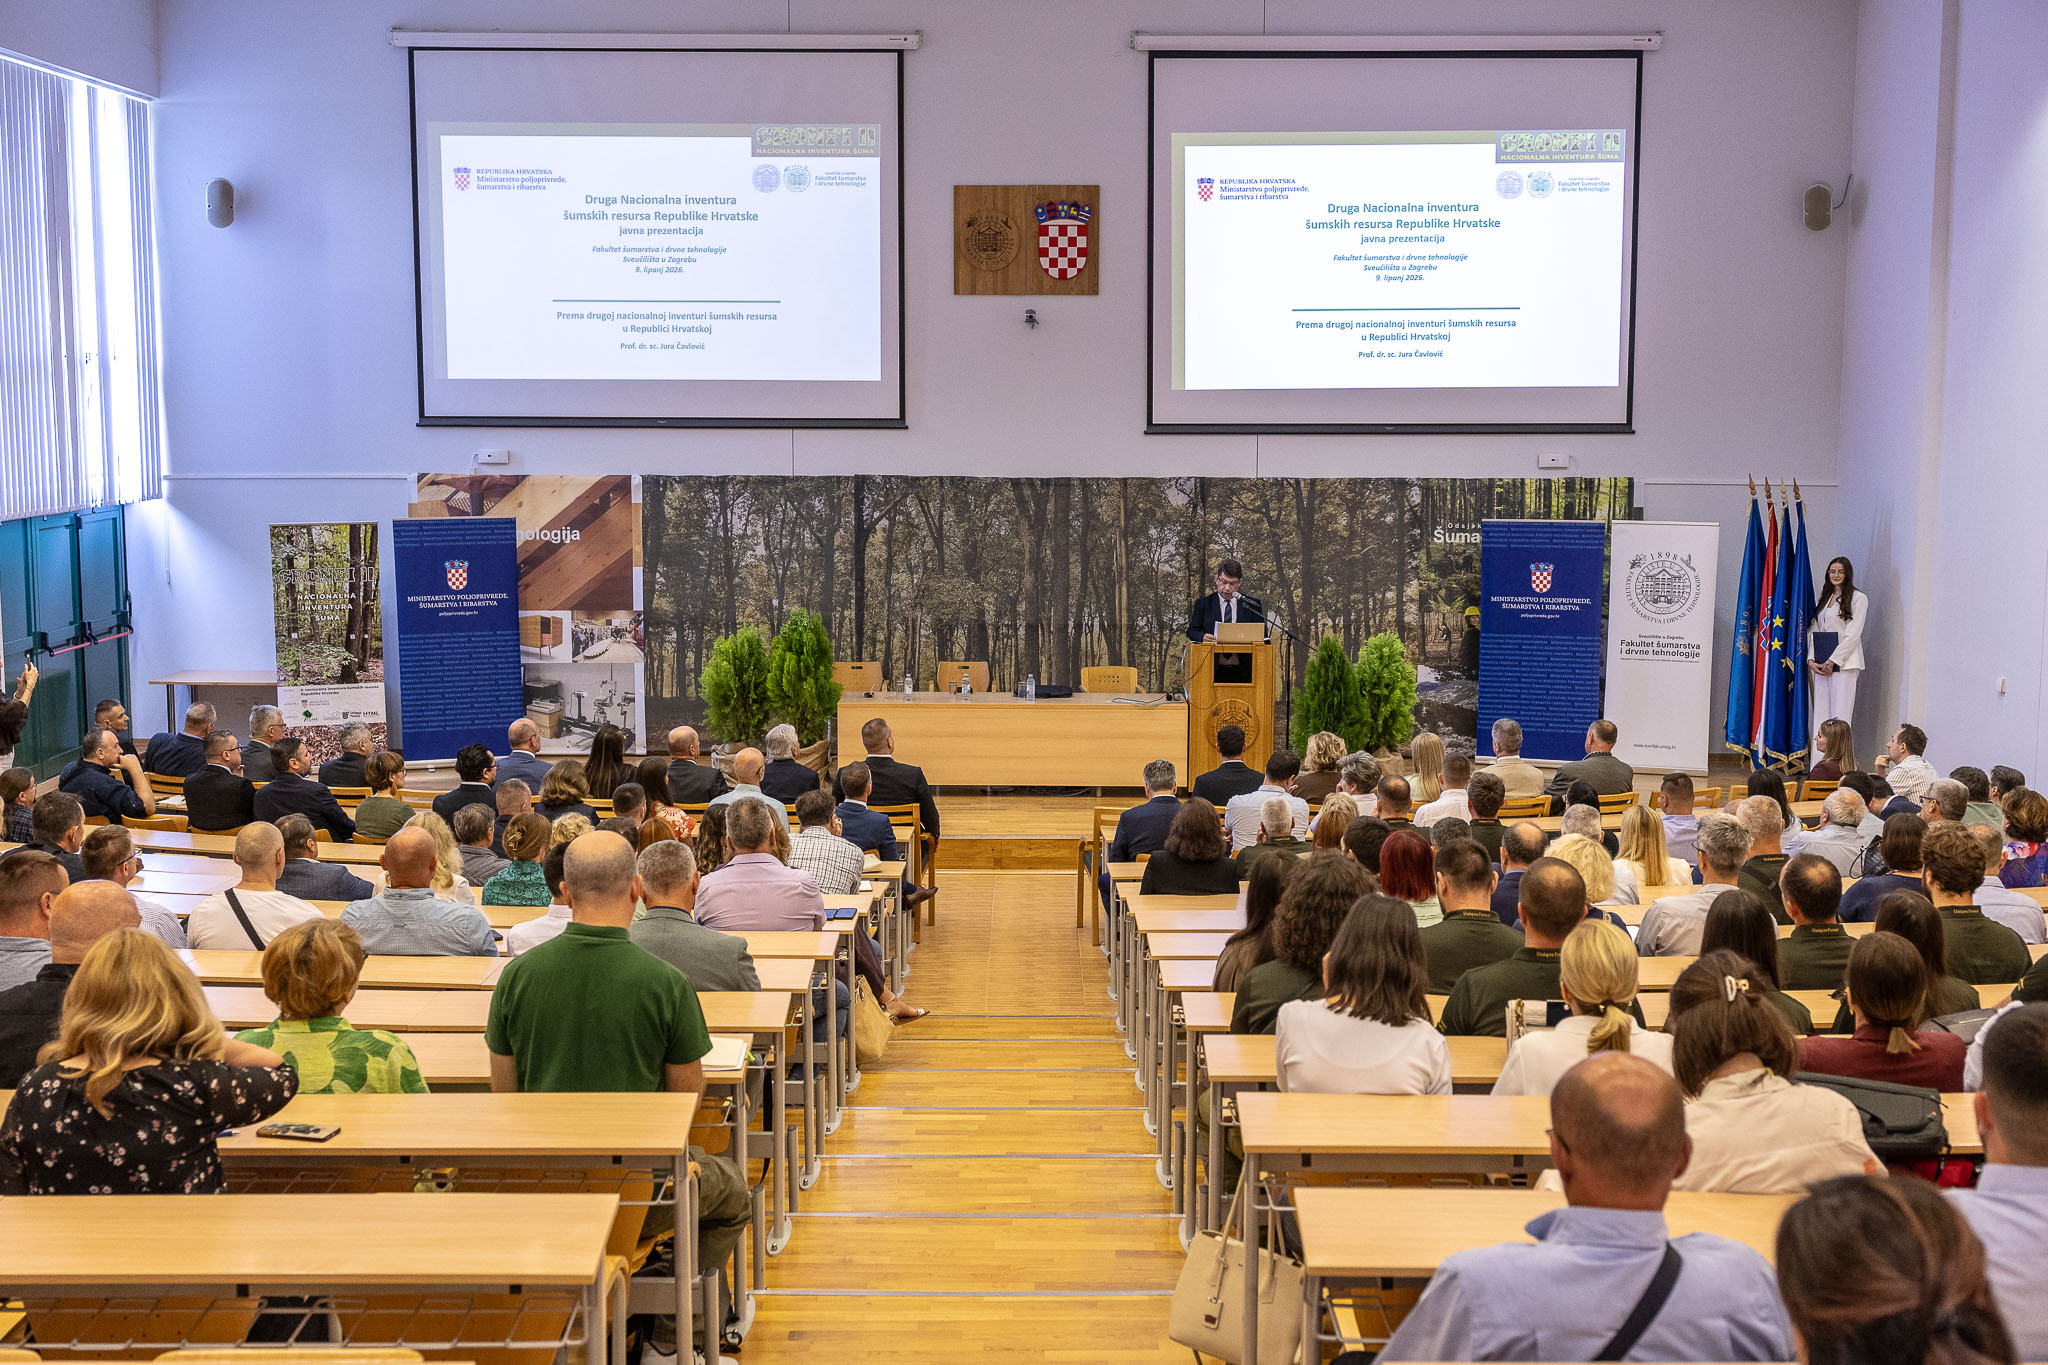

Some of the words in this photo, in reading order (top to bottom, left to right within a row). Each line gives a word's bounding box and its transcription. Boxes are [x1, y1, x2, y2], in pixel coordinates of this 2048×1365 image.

[853, 146, 875, 155] ŠUMA
[1597, 152, 1619, 160] ŠUMA
[521, 176, 567, 184] poljoprivrede,
[1264, 184, 1309, 193] poljoprivrede,
[585, 194, 617, 207] Druga
[621, 194, 681, 205] Nacionalna
[685, 194, 737, 205] inventura
[1259, 192, 1289, 200] ribarstva
[1328, 203, 1360, 215] Druga
[1363, 202, 1424, 213] Nacionalna
[1427, 202, 1479, 212] inventura
[563, 210, 608, 220] šumskih
[611, 213, 651, 221] resursa
[654, 210, 708, 223] Republike
[711, 211, 759, 221] Hrvatske
[1305, 219, 1350, 229] šumskih
[1354, 221, 1393, 229] resursa
[1396, 218, 1450, 231] Republike
[1453, 218, 1501, 228] Hrvatske
[619, 226, 645, 237] javna
[647, 226, 704, 237] prezentacija
[1360, 234, 1386, 245] javna
[1388, 234, 1445, 244] prezentacija
[592, 245, 621, 253] Fakultet
[622, 245, 660, 253] šumarstva
[687, 246, 727, 255] tehnologije
[622, 255, 660, 263] Sveučilišta
[667, 256, 697, 265] Zagrebu
[1428, 253, 1468, 262] tehnologije
[643, 266, 664, 275] lipanj
[1408, 264, 1438, 272] Zagrebu
[1384, 274, 1404, 283] lipanj
[586, 312, 614, 322] drugoj
[616, 311, 666, 322] nacionalnoj
[668, 312, 707, 320] inventuri
[709, 312, 744, 320] šumskih
[1296, 321, 1323, 329] Prema
[1325, 320, 1353, 330] drugoj
[1355, 320, 1405, 330] nacionalnoj
[1407, 319, 1446, 328] inventuri
[1448, 319, 1483, 327] šumskih
[630, 324, 670, 334] Republici
[672, 324, 712, 335] Hrvatskoj
[1369, 333, 1408, 343] Republici
[1410, 332, 1451, 342] Hrvatskoj
[676, 341, 705, 350] Čavlović
[1414, 349, 1443, 358] Čavlović
[1447, 522, 1482, 530] Odsjek
[516, 526, 580, 544] nologija
[1433, 525, 1481, 543] Šuma
[1650, 551, 1679, 561] 1898
[297, 592, 356, 601] NACIONALNA
[407, 594, 456, 602] MINISTARSTVO
[457, 593, 509, 601] POLJOPRIVREDE,
[1540, 597, 1592, 605] POLJOPRIVREDE,
[301, 603, 353, 611] INVENTURA
[419, 601, 459, 609] ŠUMARSTVA
[463, 600, 498, 608] RIBARSTVA
[1502, 602, 1541, 610] ŠUMARSTVA
[315, 612, 341, 621] ŠUMA
[1620, 640, 1655, 648] Fakultet
[1656, 640, 1701, 650] šumarstva
[1625, 648, 1650, 656] drvne
[1652, 648, 1701, 659] tehnologije
